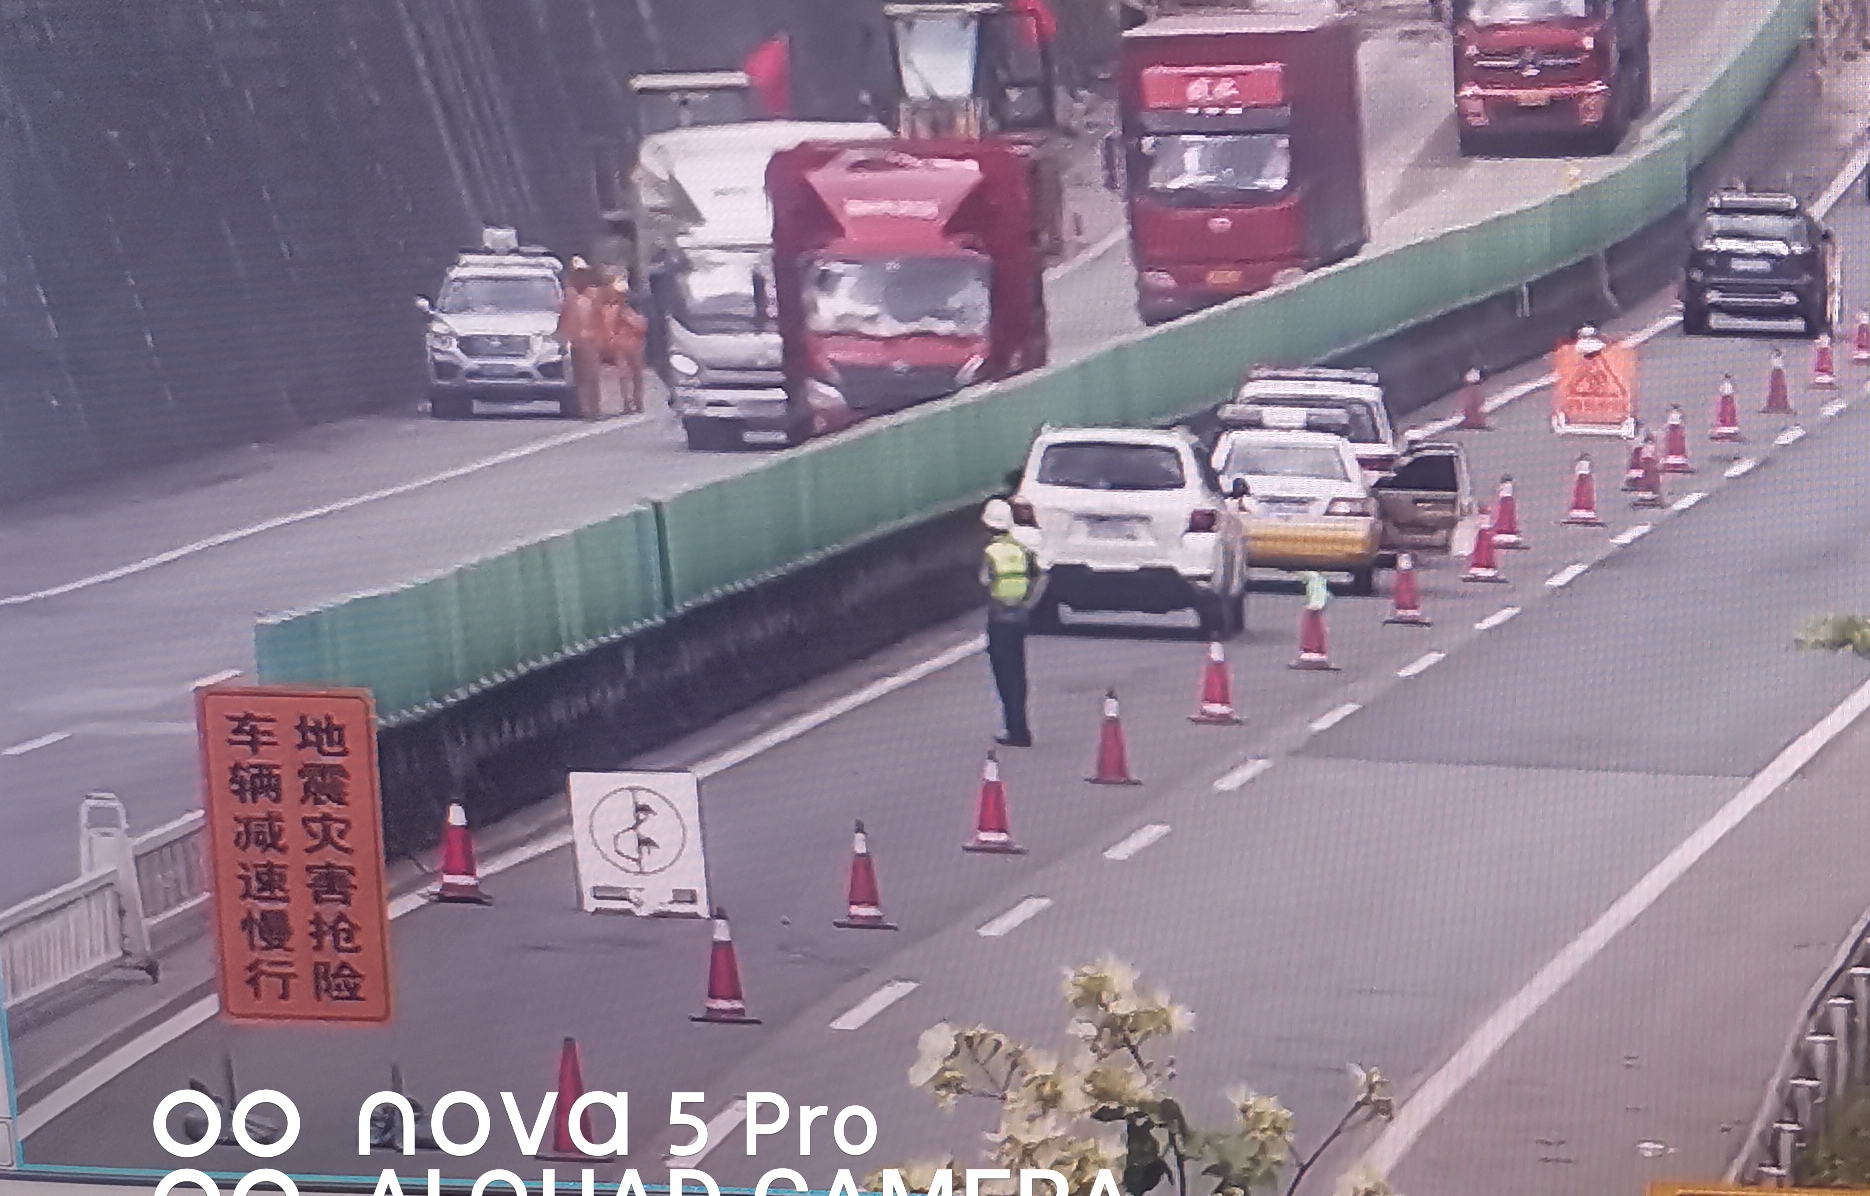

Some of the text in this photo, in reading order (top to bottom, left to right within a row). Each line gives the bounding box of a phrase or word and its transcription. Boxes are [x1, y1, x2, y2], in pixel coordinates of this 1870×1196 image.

[224, 712, 299, 1002] 车辆减速慢行
[296, 713, 366, 1003] 地震灾害抢险
